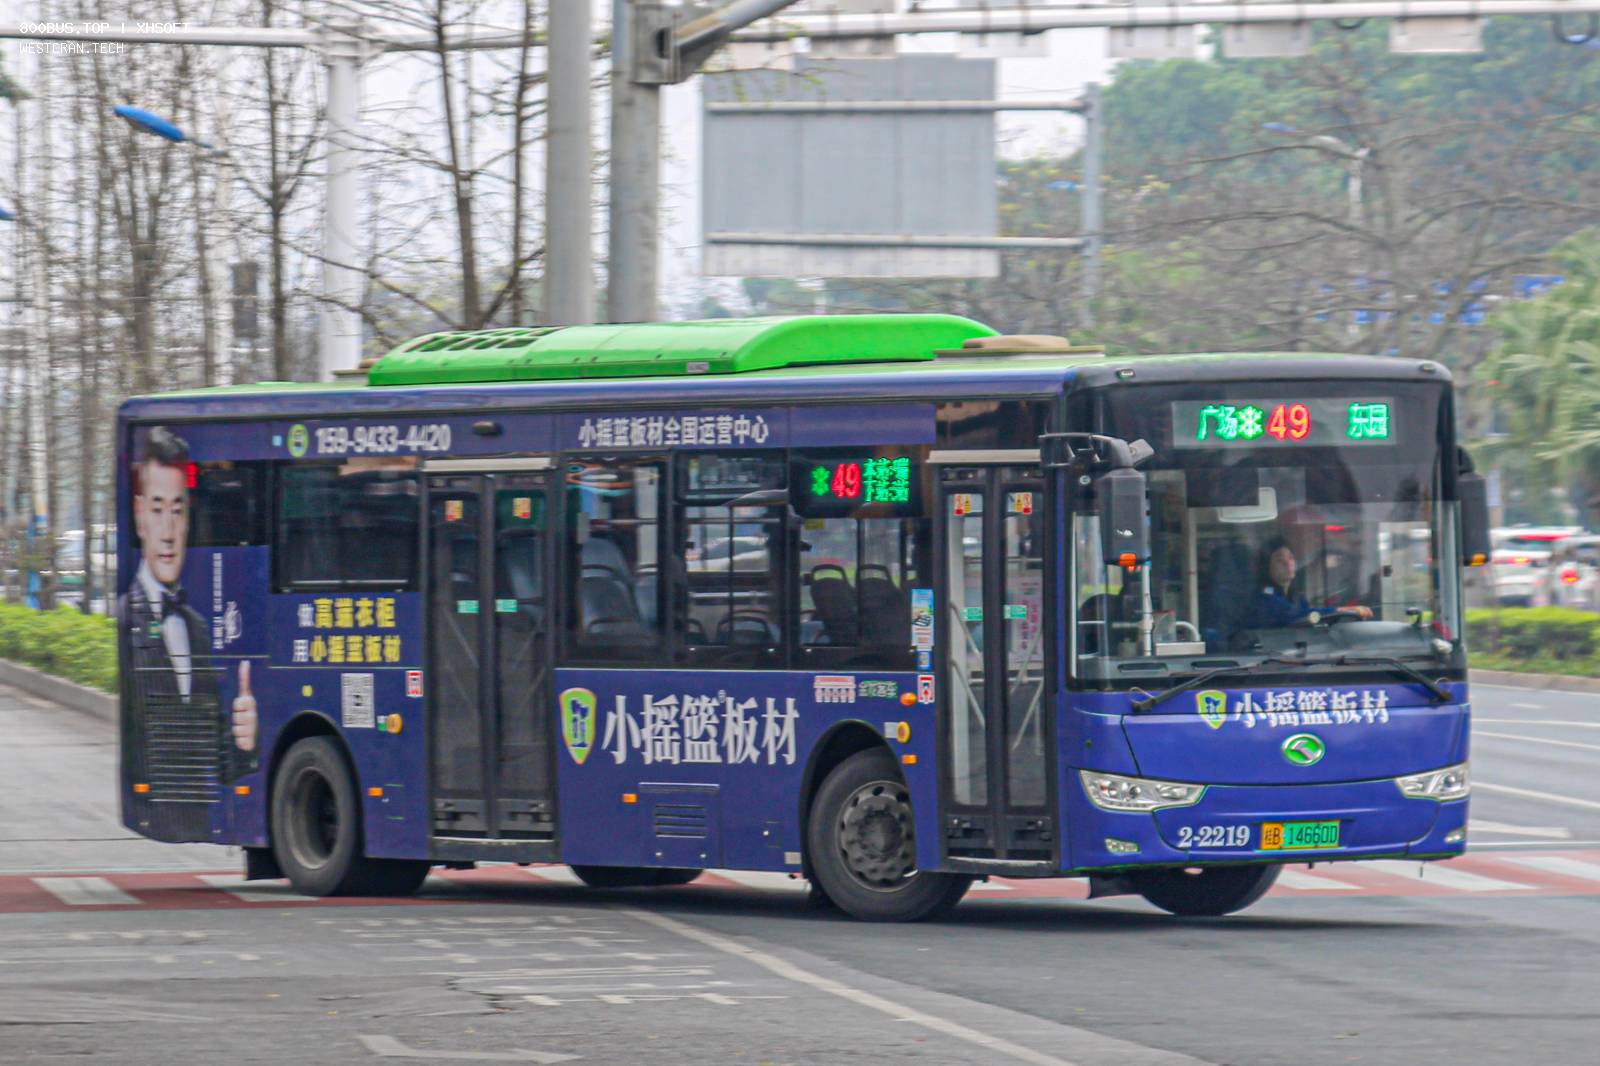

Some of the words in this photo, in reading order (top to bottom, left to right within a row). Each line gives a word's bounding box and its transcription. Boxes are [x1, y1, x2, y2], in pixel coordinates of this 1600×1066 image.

[315, 424, 452, 453] 159-9433-4420
[578, 415, 769, 448] 小摇篮板材全国运营中心
[1198, 404, 1238, 440] 广场
[1267, 404, 1311, 440] 49
[832, 463, 861, 498] 49
[1235, 689, 1390, 728] 小摇篮板材
[601, 693, 801, 766] 小摇篮板材
[1177, 825, 1251, 849] 2-2219
